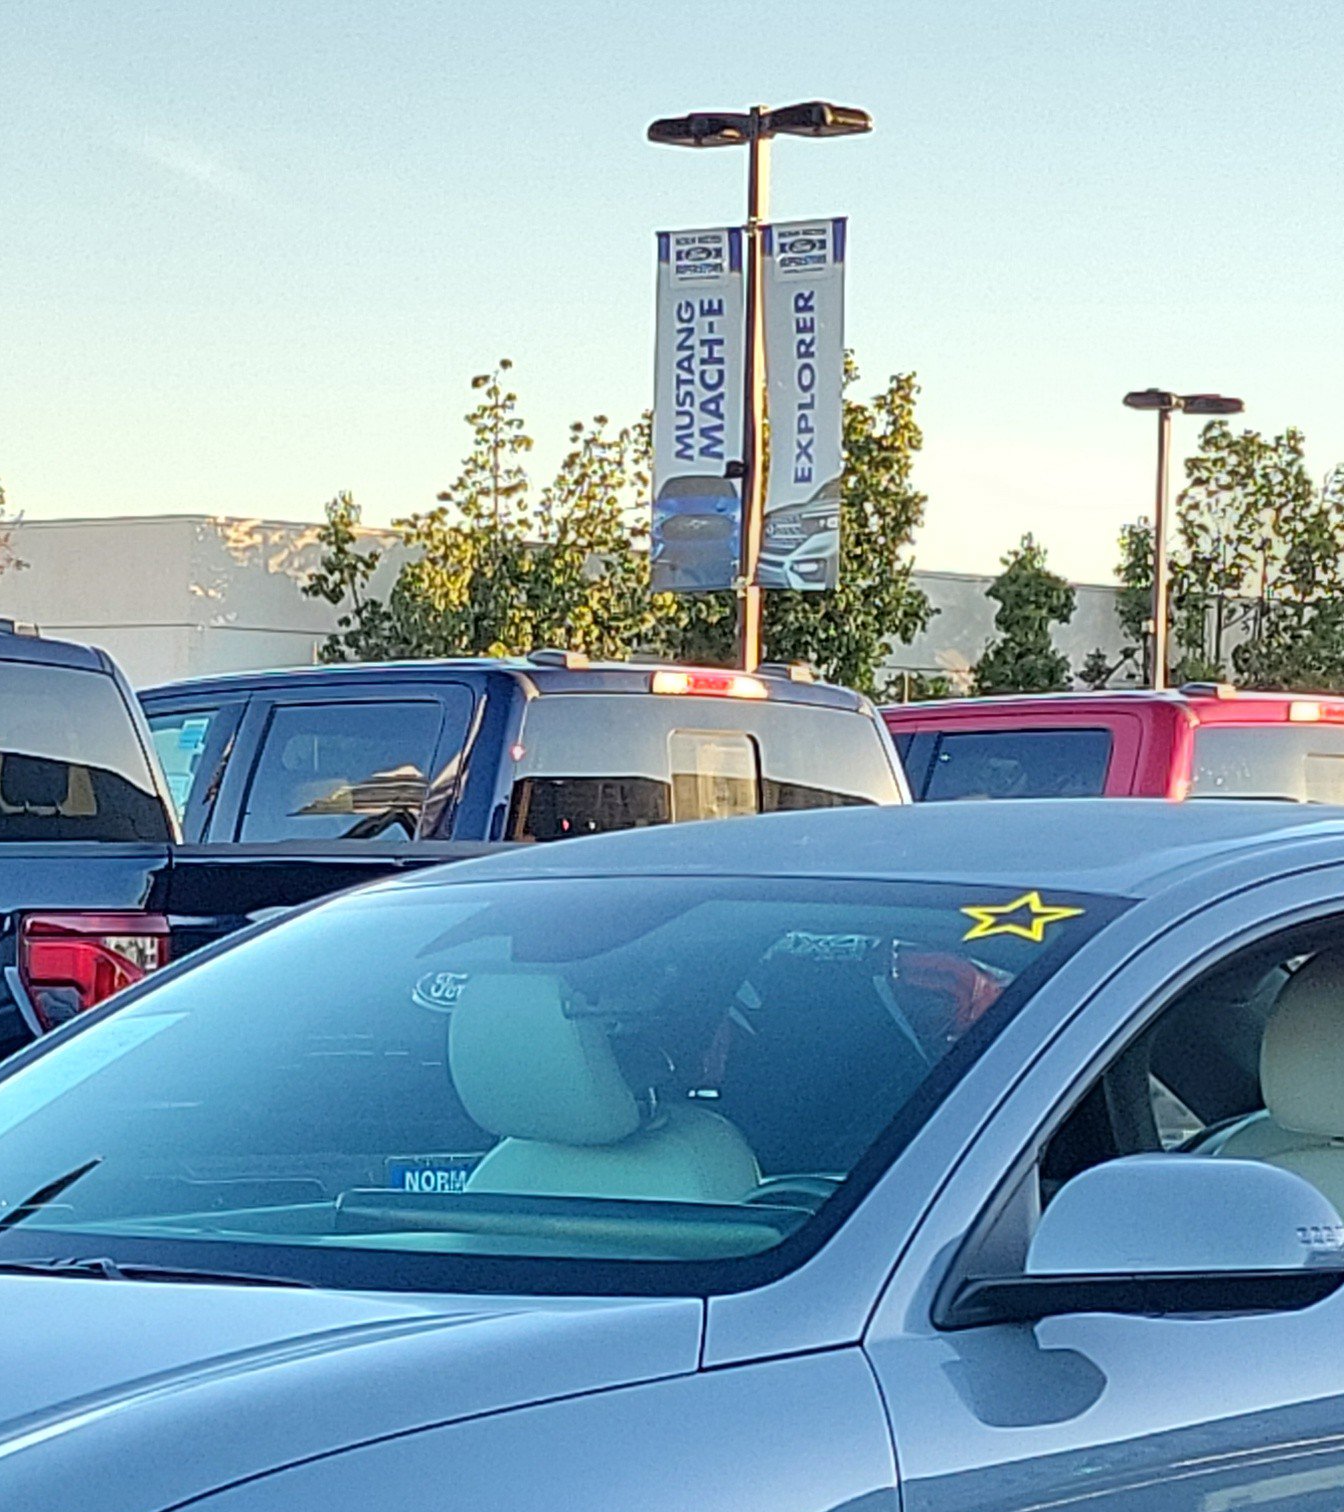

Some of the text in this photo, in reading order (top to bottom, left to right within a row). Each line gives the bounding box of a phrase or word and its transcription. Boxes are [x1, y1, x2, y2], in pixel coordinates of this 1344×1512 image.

[675, 299, 695, 462] MUSTANG
[699, 298, 725, 460] MACH-E
[794, 290, 816, 484] EXPLORER
[430, 972, 469, 999] For
[405, 1170, 467, 1192] NORM
